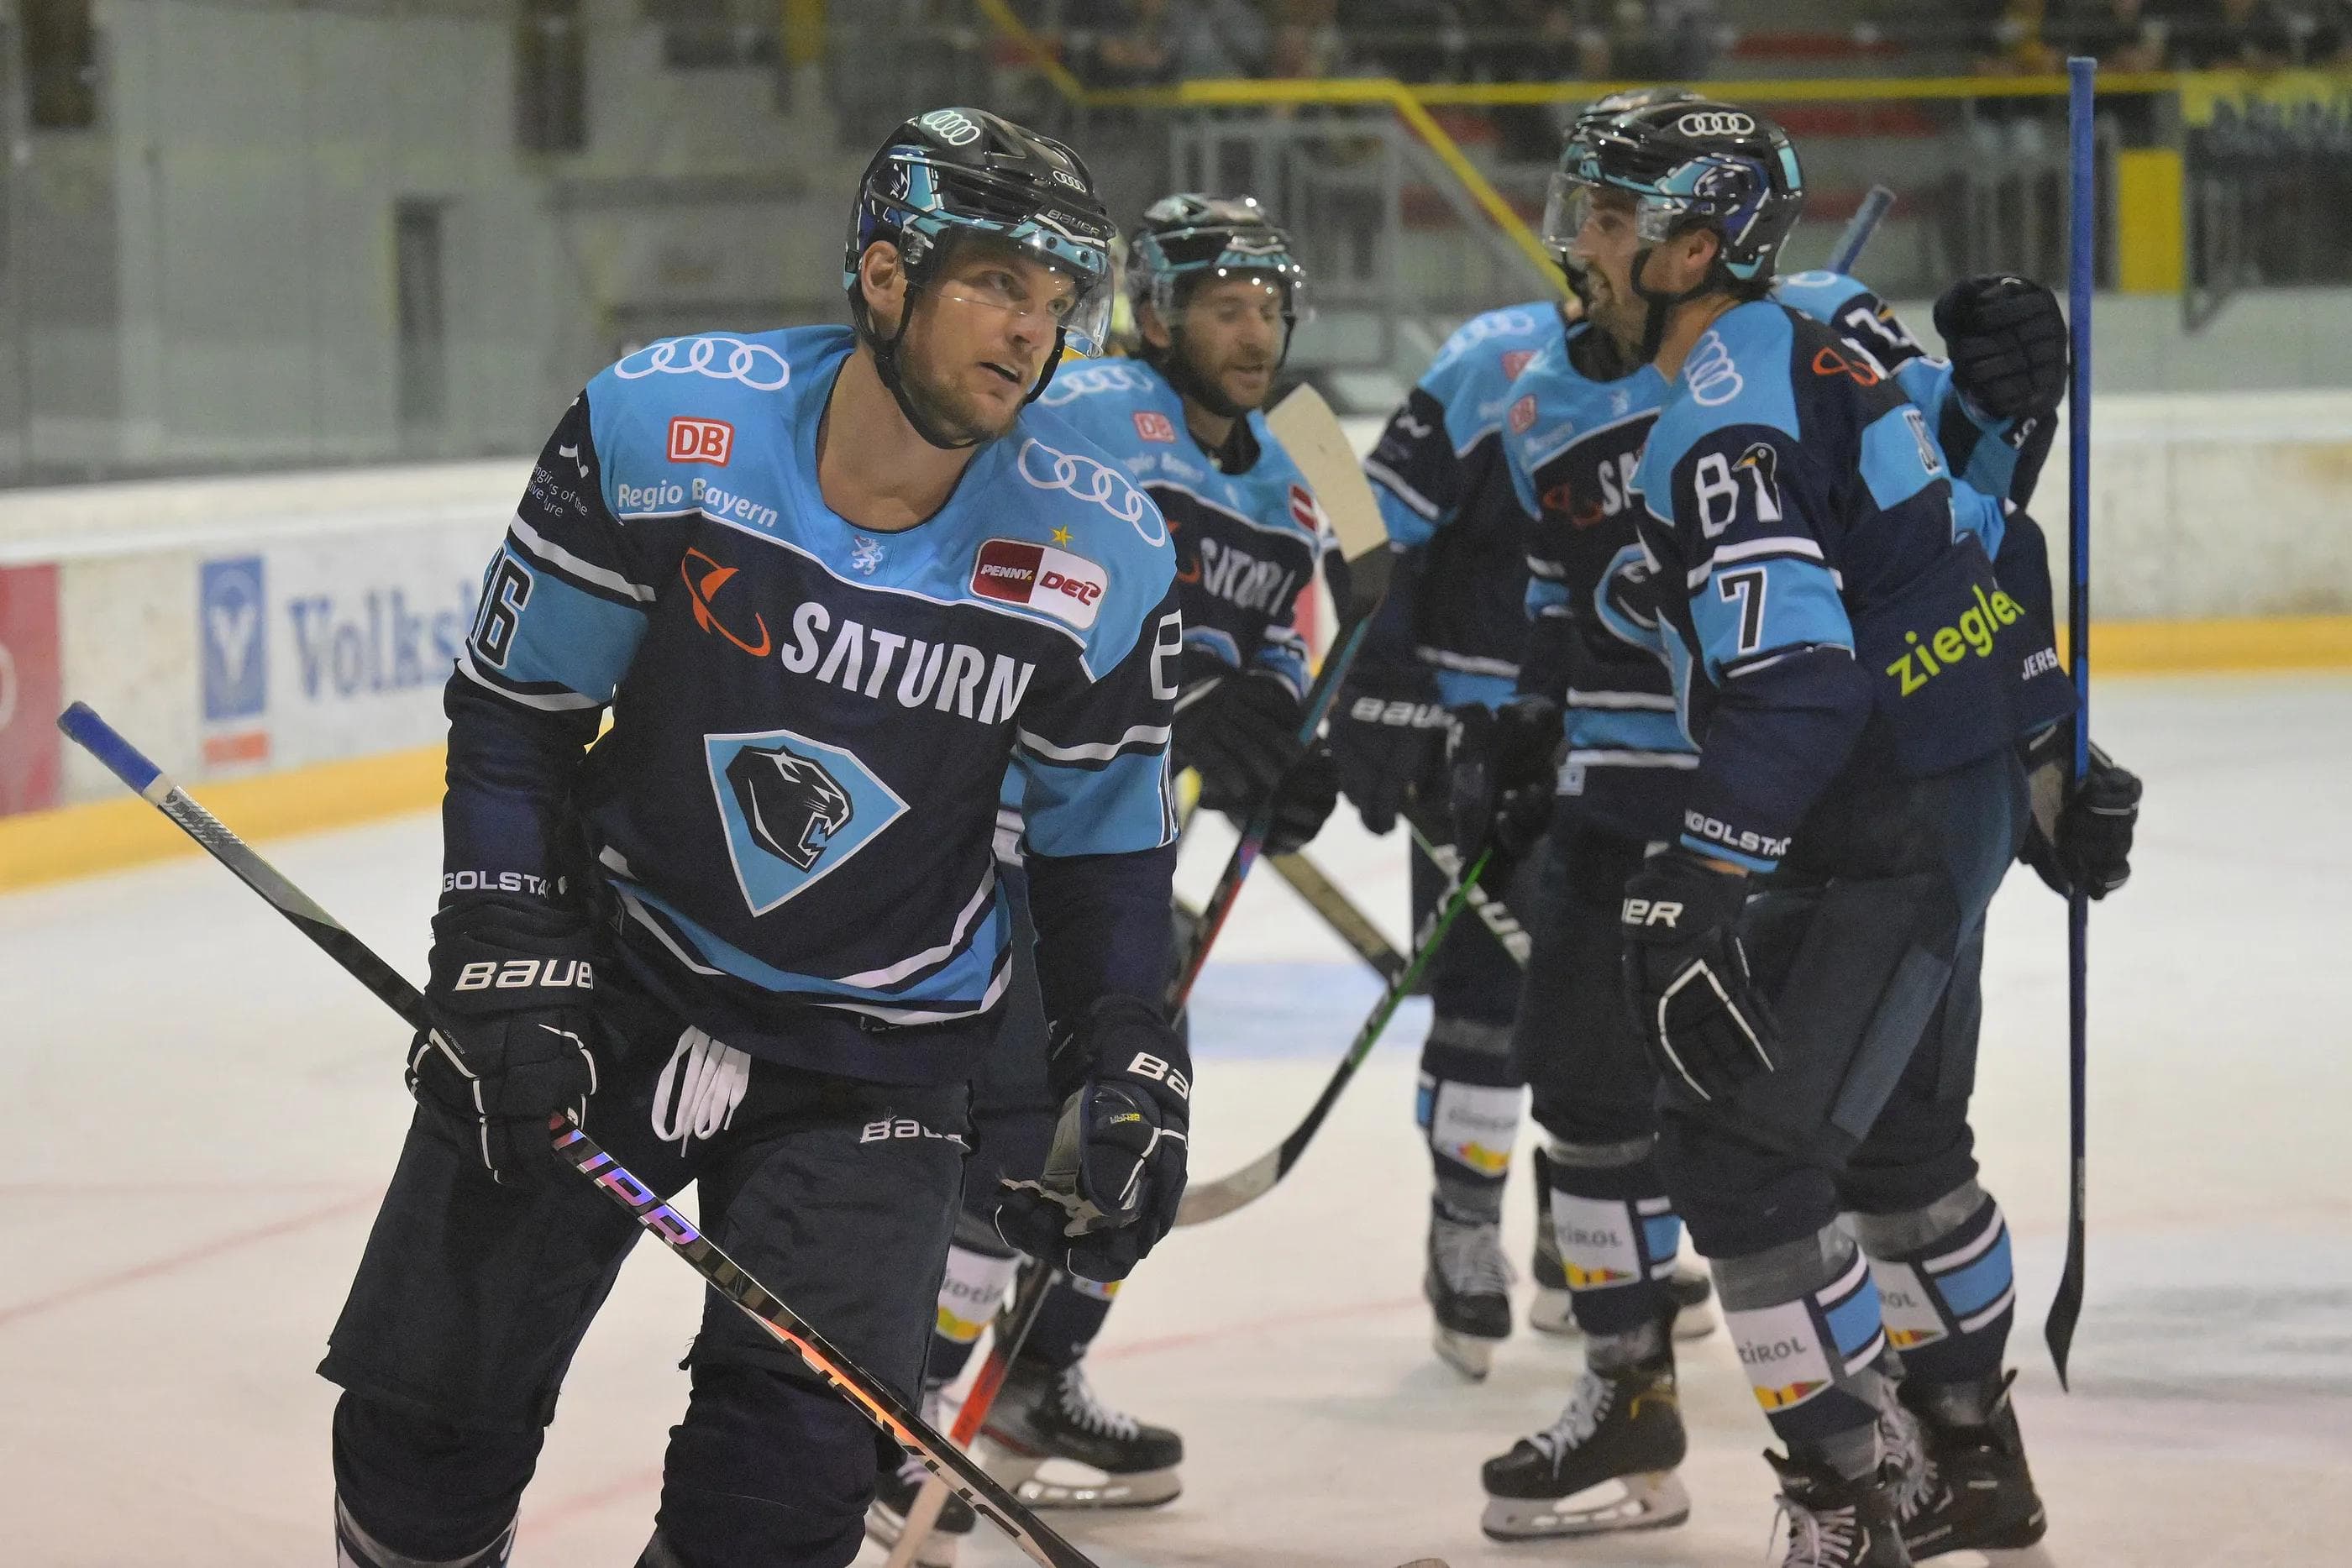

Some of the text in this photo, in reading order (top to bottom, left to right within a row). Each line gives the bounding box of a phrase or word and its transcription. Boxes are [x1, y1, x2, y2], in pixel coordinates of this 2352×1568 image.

[675, 423, 725, 457] DB
[560, 490, 577, 503] of
[575, 496, 588, 517] the
[617, 477, 778, 528] Regio Bayern
[1039, 570, 1102, 606] DEL
[1718, 566, 1767, 657] 7
[781, 601, 1037, 726] SATURN
